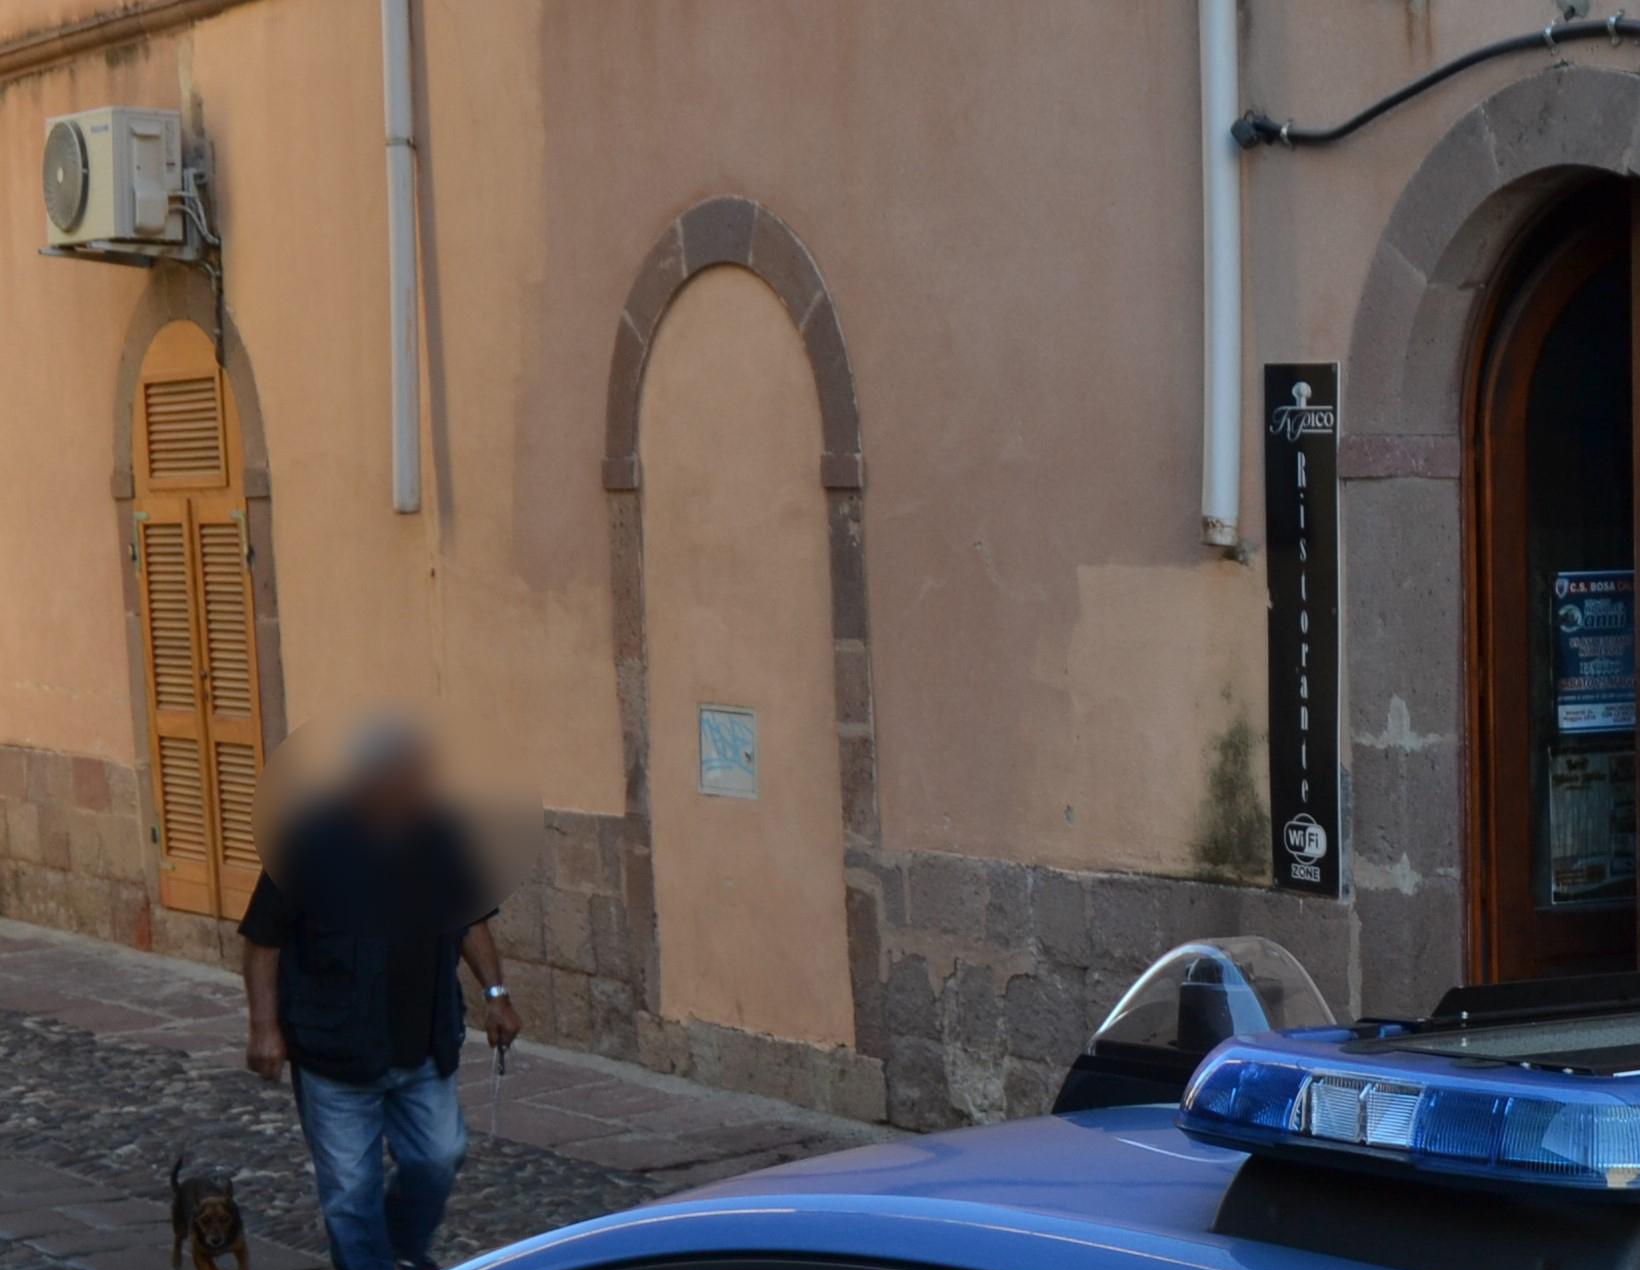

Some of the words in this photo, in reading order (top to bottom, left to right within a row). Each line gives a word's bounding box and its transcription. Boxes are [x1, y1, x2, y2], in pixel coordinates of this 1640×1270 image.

[1590, 581, 1616, 592] BOSA
[1297, 451, 1311, 803] Ristorante
[1290, 864, 1321, 883] ZONE
